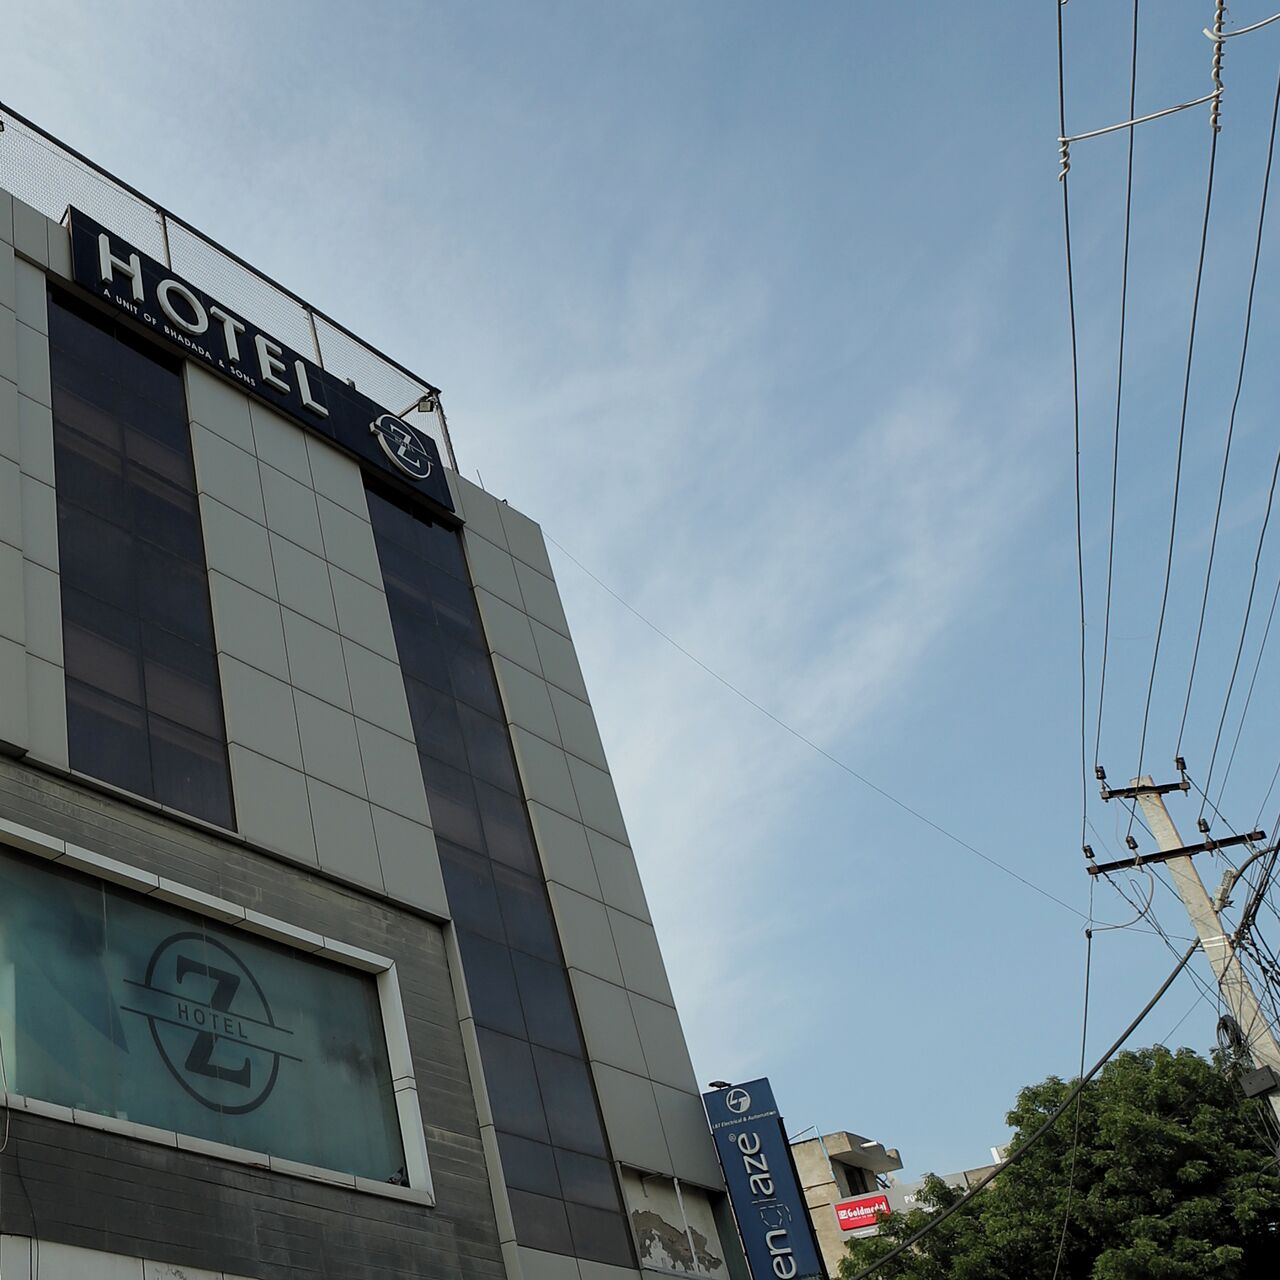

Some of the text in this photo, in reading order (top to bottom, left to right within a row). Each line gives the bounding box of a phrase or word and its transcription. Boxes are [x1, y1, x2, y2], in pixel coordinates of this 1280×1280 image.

[98, 232, 330, 418] HOTEL
[103, 288, 256, 387] A UNIT OF BHADADA & SONS
[176, 954, 252, 1089] Z
[177, 1003, 248, 1039] HOTEL
